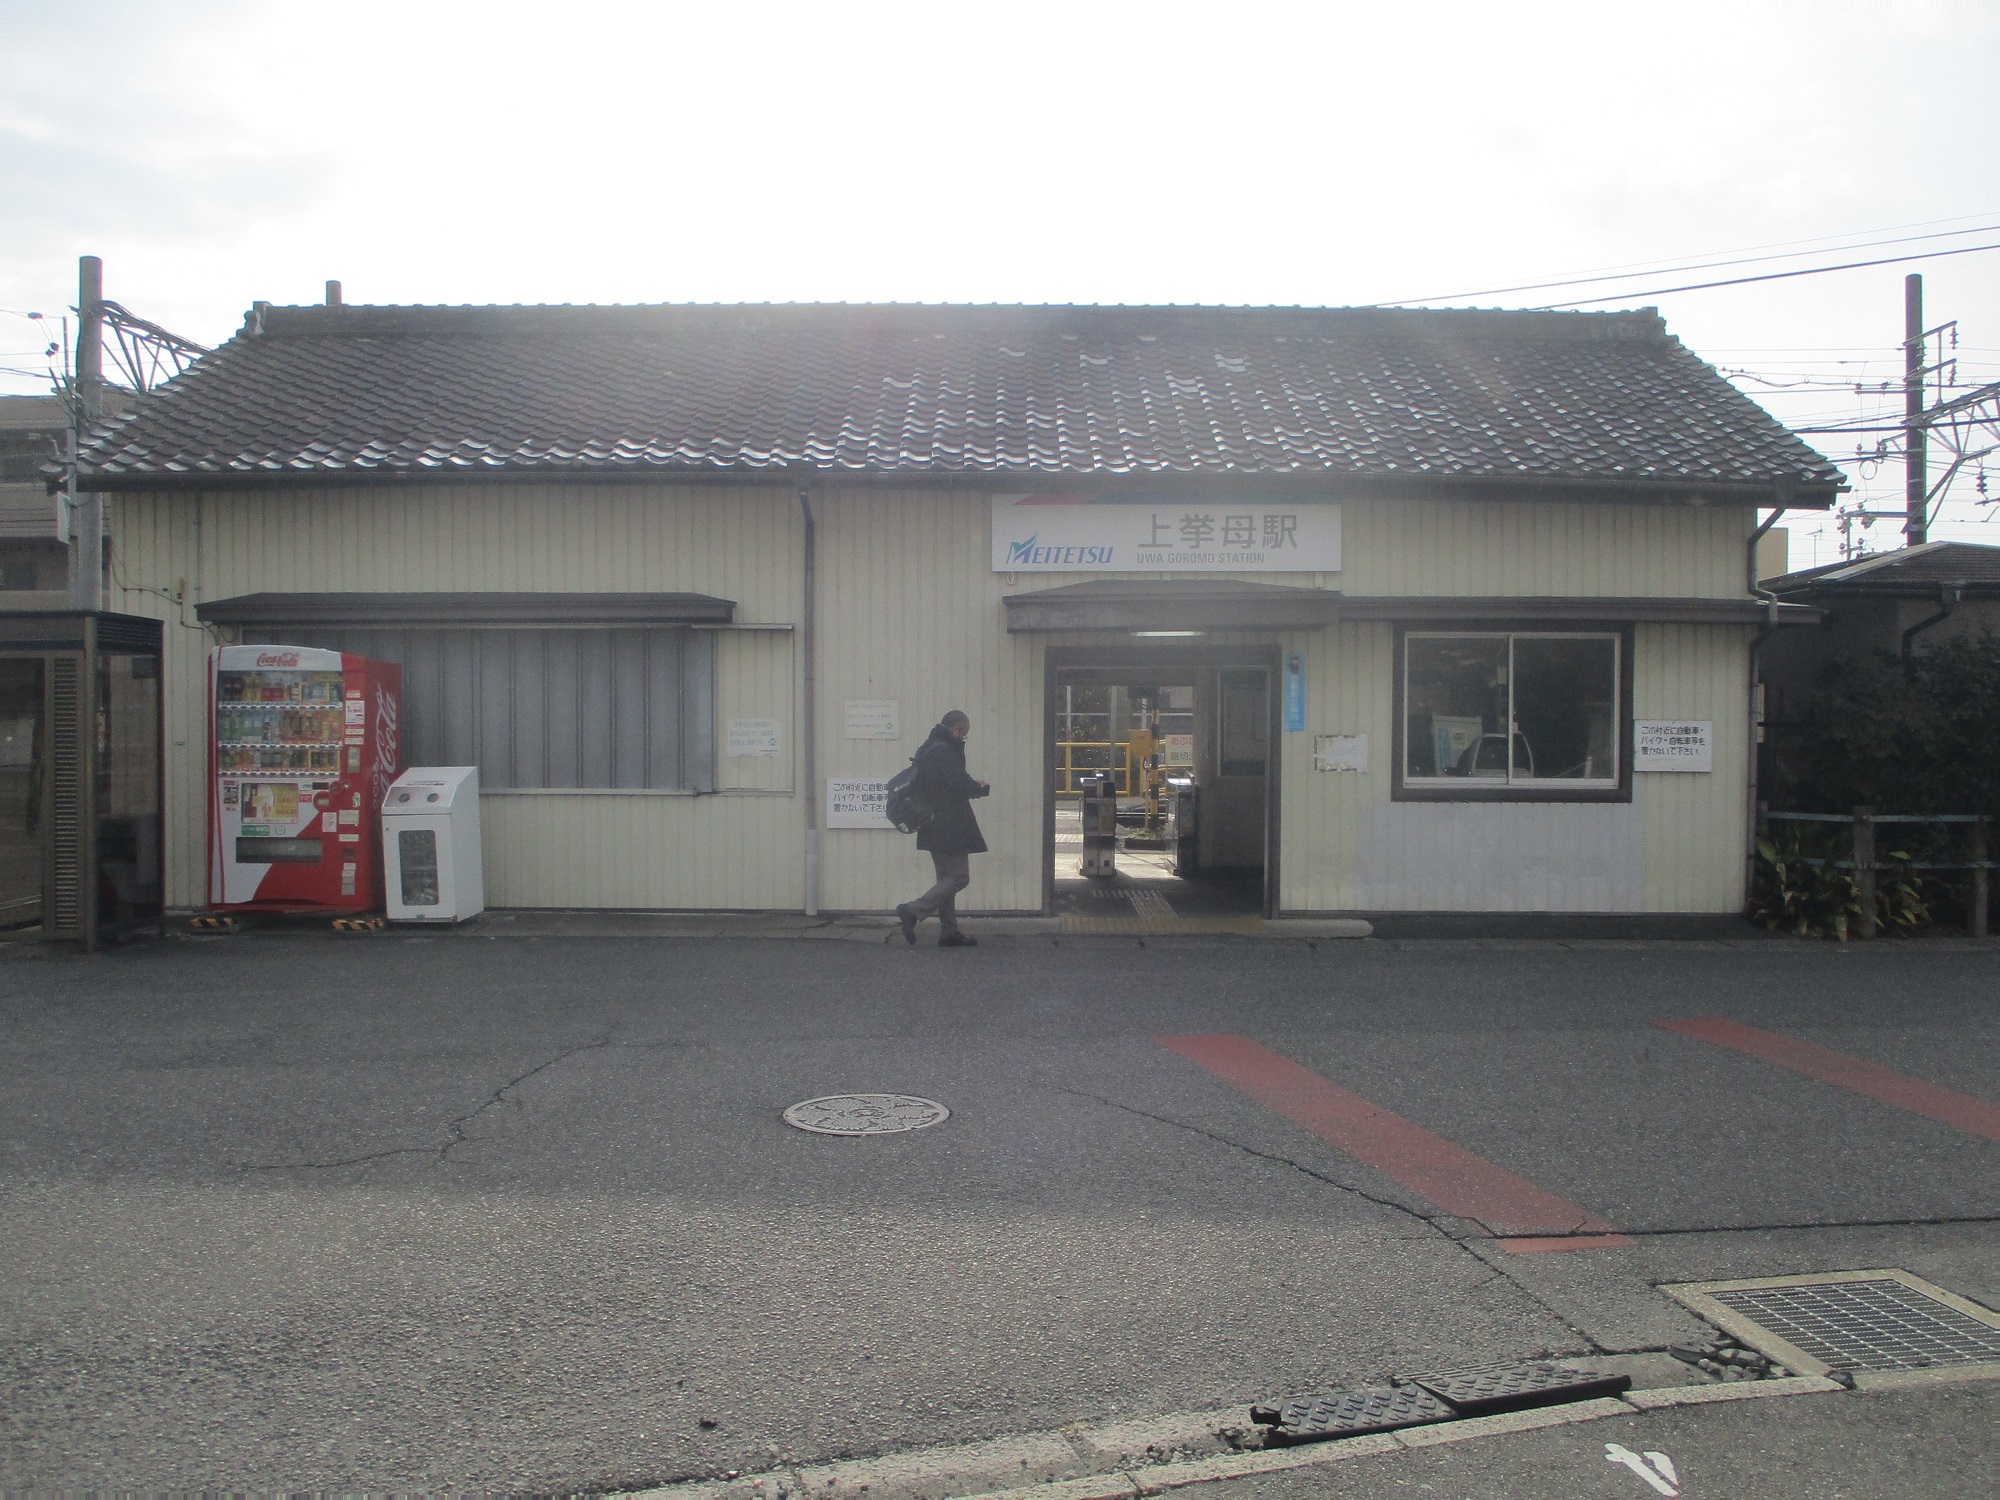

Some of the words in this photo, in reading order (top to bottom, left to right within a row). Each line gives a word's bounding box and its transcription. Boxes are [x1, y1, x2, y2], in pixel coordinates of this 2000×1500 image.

[1137, 513, 1298, 550] 上挙母駅
[1006, 533, 1114, 564] MEITETSU
[1137, 553, 1164, 564] UWA
[1168, 553, 1215, 564] GOROMO
[1218, 553, 1265, 564] STATION
[257, 652, 301, 668] Coca-Cola
